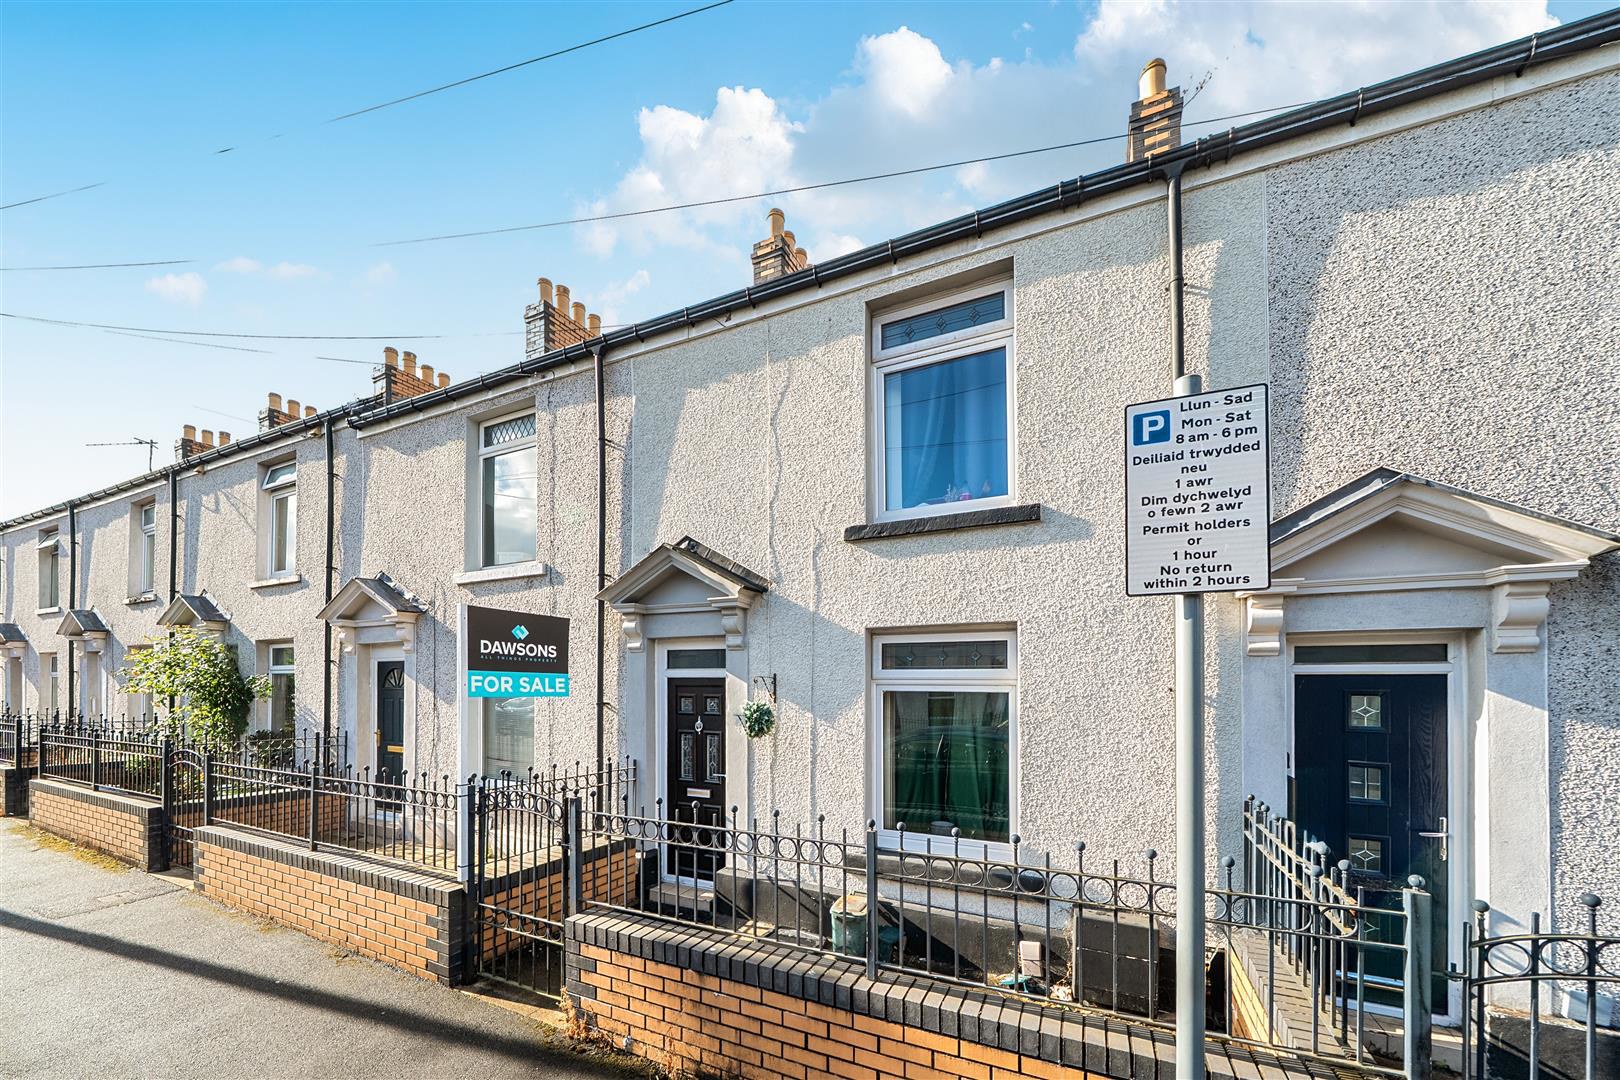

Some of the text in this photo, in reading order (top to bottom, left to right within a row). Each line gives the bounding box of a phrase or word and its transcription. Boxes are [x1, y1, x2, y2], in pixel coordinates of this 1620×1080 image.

[1180, 401, 1211, 412] Llun
[1223, 392, 1253, 405] Sad
[1181, 418, 1212, 429] Mon
[1225, 410, 1252, 423] Sat
[1142, 415, 1165, 442] P
[1175, 434, 1185, 444] 8
[1188, 432, 1209, 442] am
[1222, 427, 1231, 438] 6
[1235, 426, 1258, 438] pm
[1133, 440, 1260, 466] Deiliaid trwydded
[1181, 463, 1207, 474] neu
[1175, 477, 1213, 489] 1 awr
[1141, 486, 1251, 506] Dim dychwelyd
[1147, 501, 1243, 518] o fewn 2 awr
[1143, 518, 1251, 535] Permit holders
[1187, 536, 1202, 546] or
[1172, 550, 1218, 561] 1 hour
[1160, 563, 1232, 575] No return
[1143, 575, 1251, 589] within 2 hours
[480, 639, 557, 658] DAWSONS
[470, 675, 566, 693] FOR SALE
